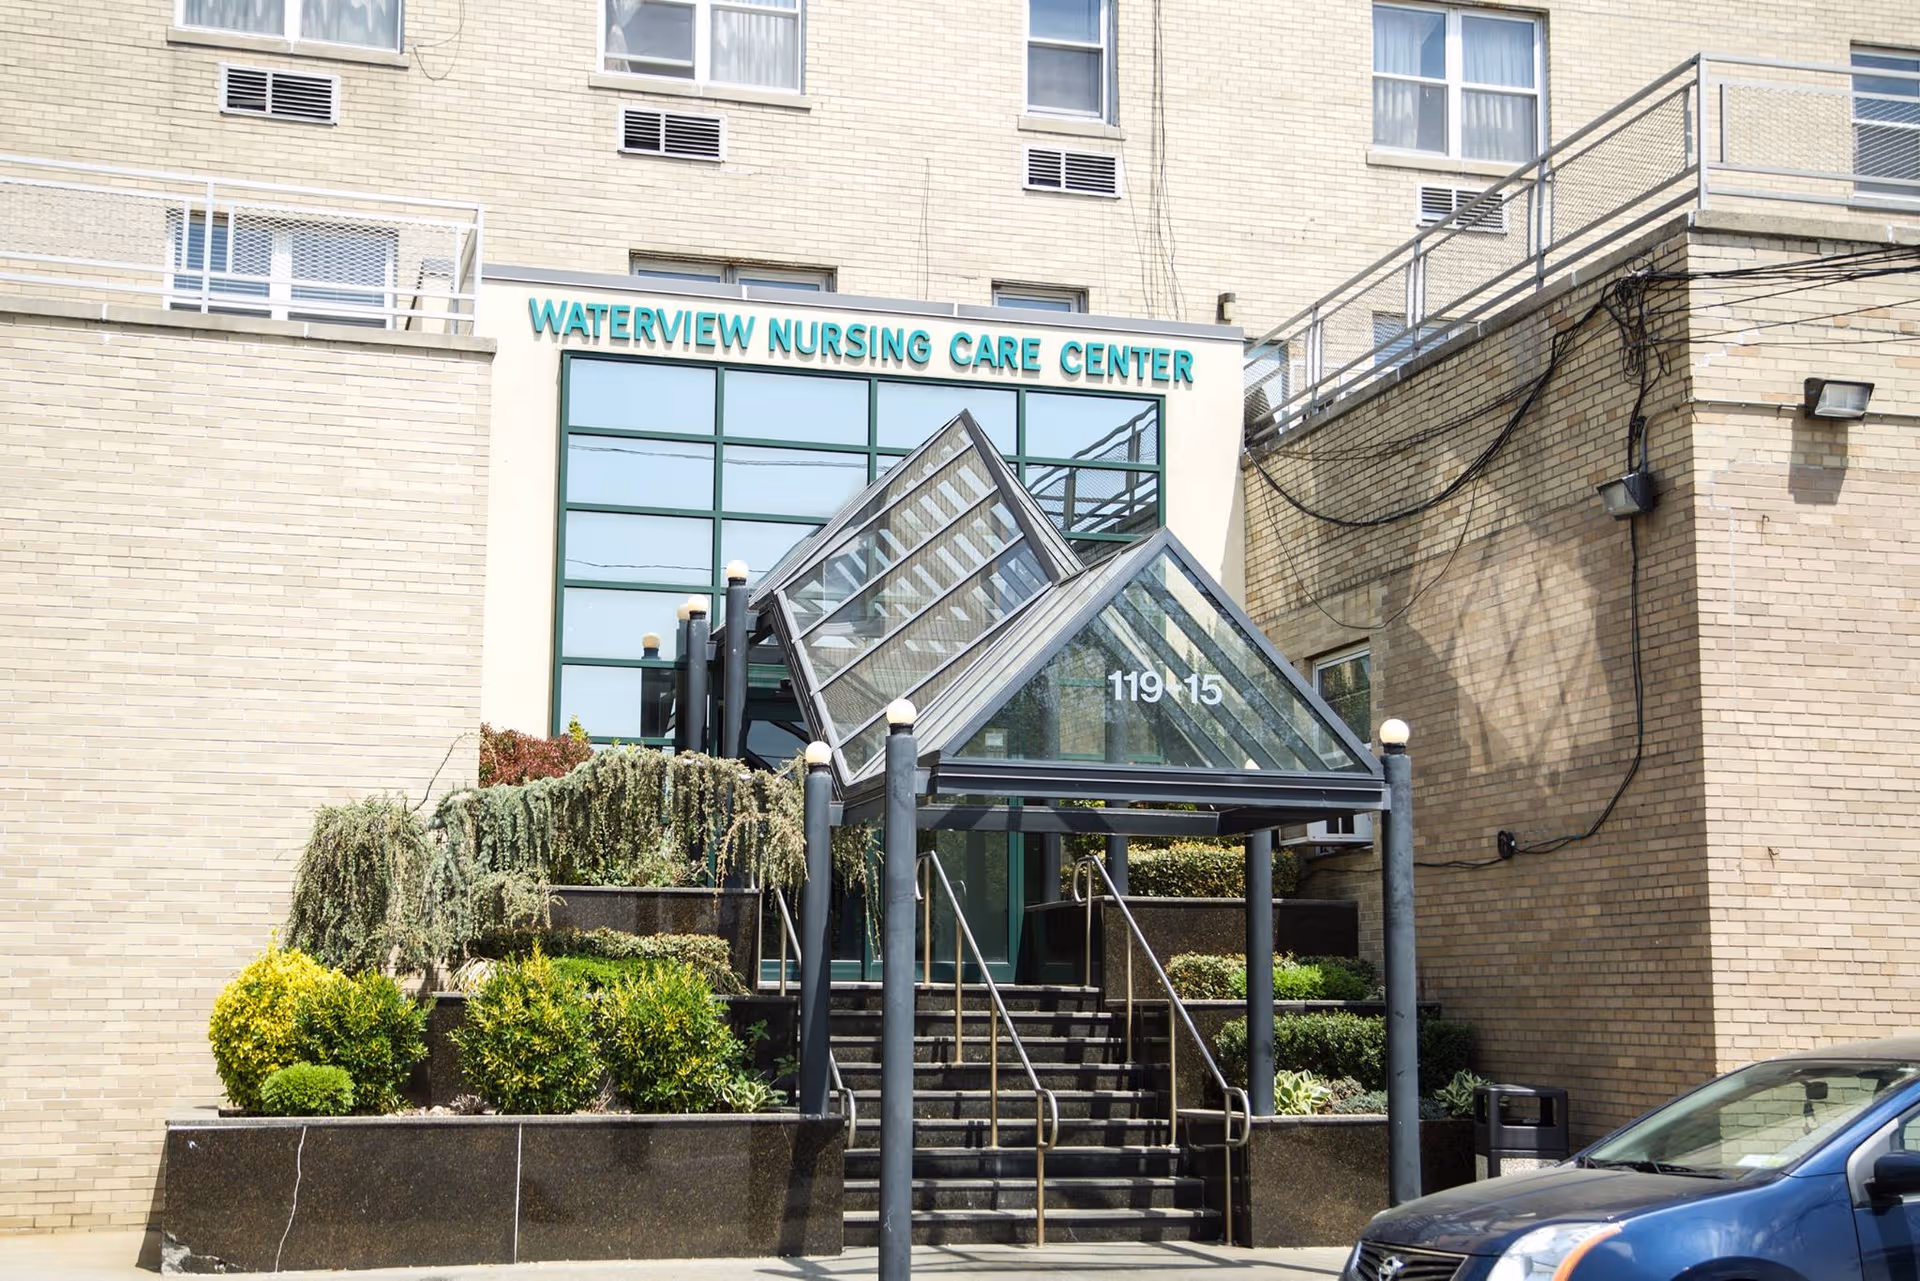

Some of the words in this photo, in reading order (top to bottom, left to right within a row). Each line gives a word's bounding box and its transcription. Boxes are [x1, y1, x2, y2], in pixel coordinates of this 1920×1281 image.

[528, 298, 756, 349] WATERVIEW
[768, 318, 932, 364] NURSING
[949, 331, 1041, 371] CARE
[1059, 341, 1194, 382] CENTER
[1108, 670, 1223, 705] 119-15
